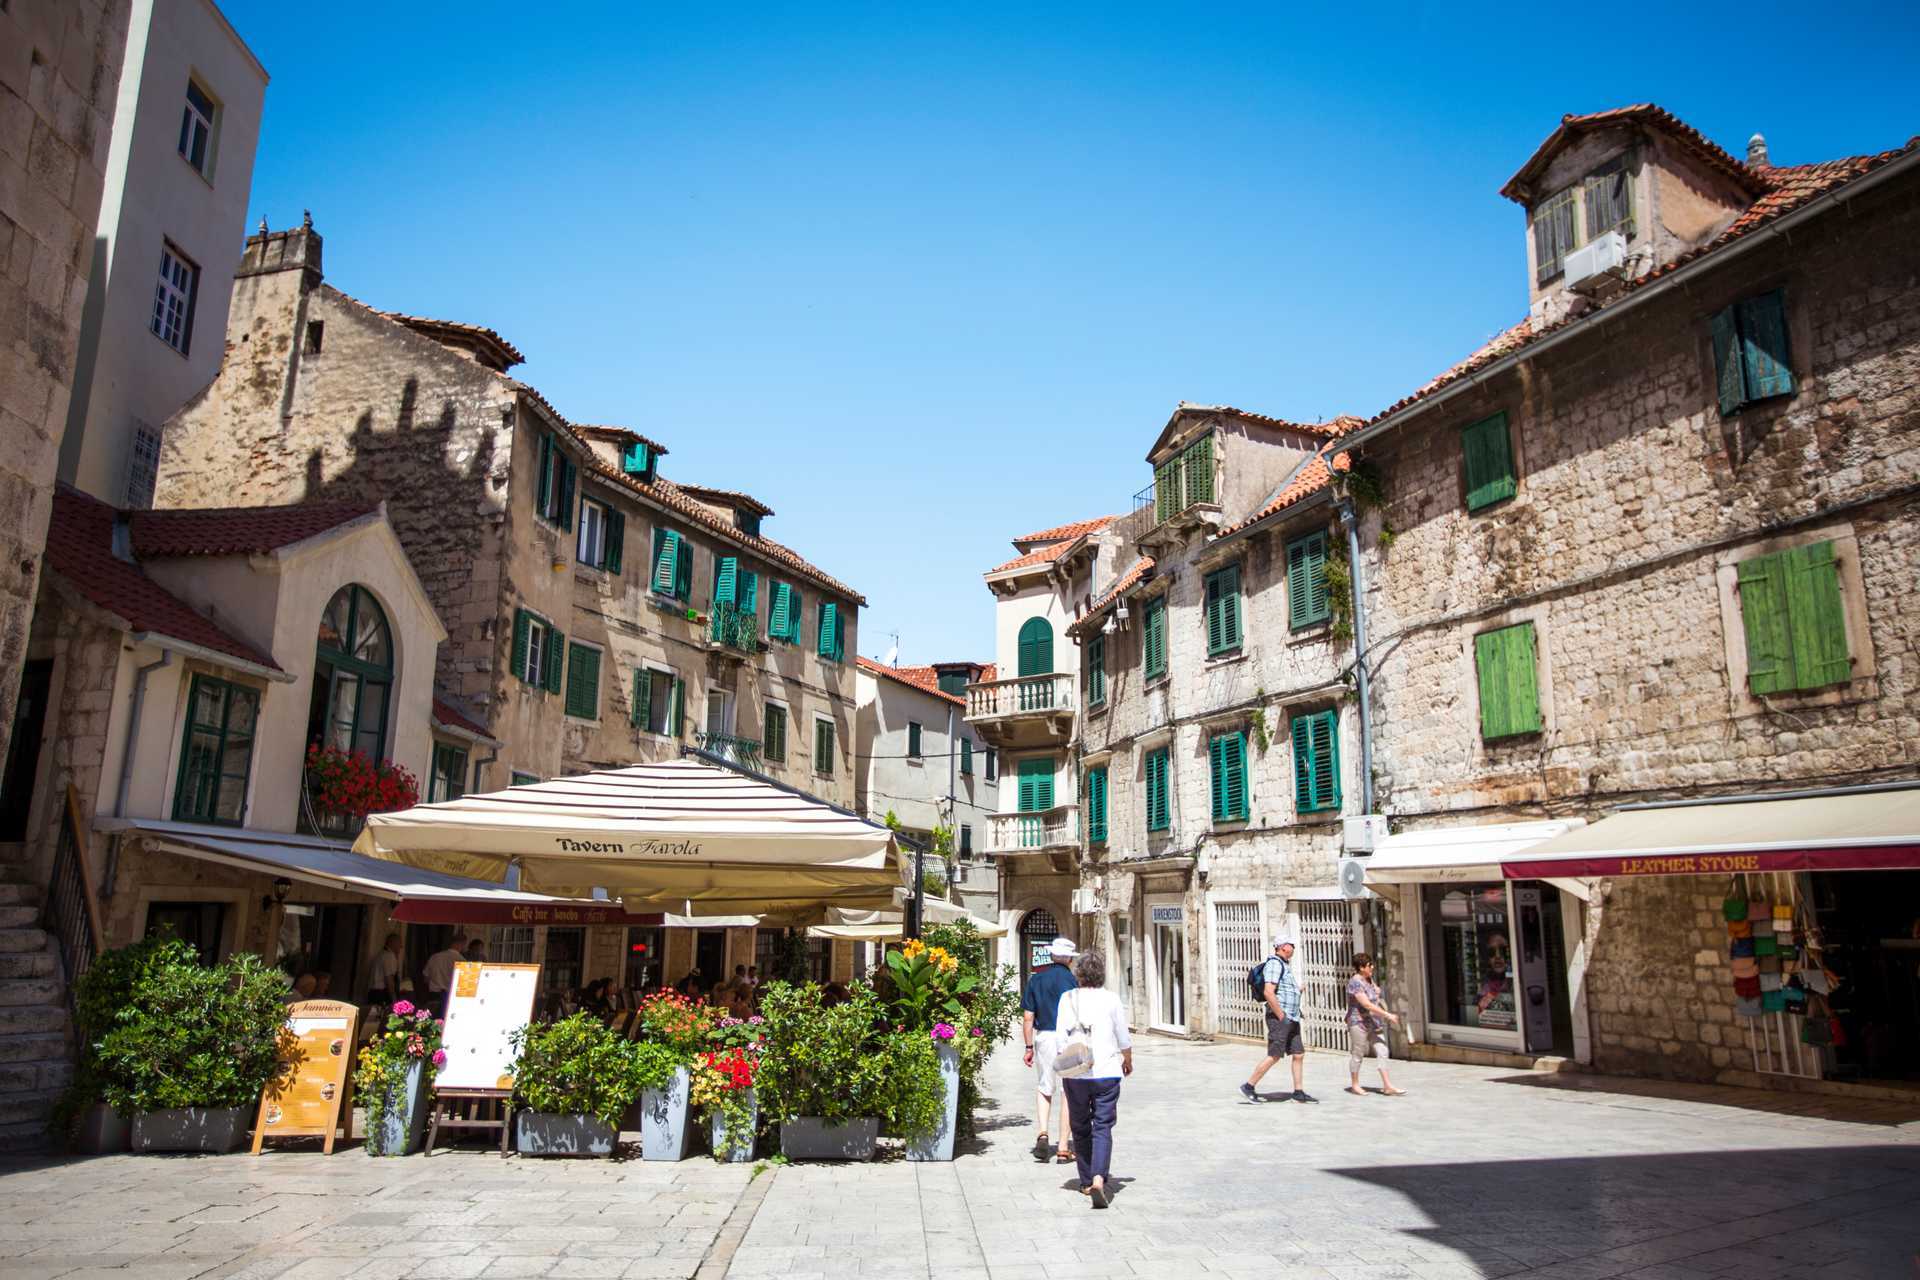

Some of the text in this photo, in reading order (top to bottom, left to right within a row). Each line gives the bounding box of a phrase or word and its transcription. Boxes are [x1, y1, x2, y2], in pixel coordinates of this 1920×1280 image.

[556, 838, 702, 855] Tavern Favola
[1621, 855, 1760, 874] LEATHER STORE
